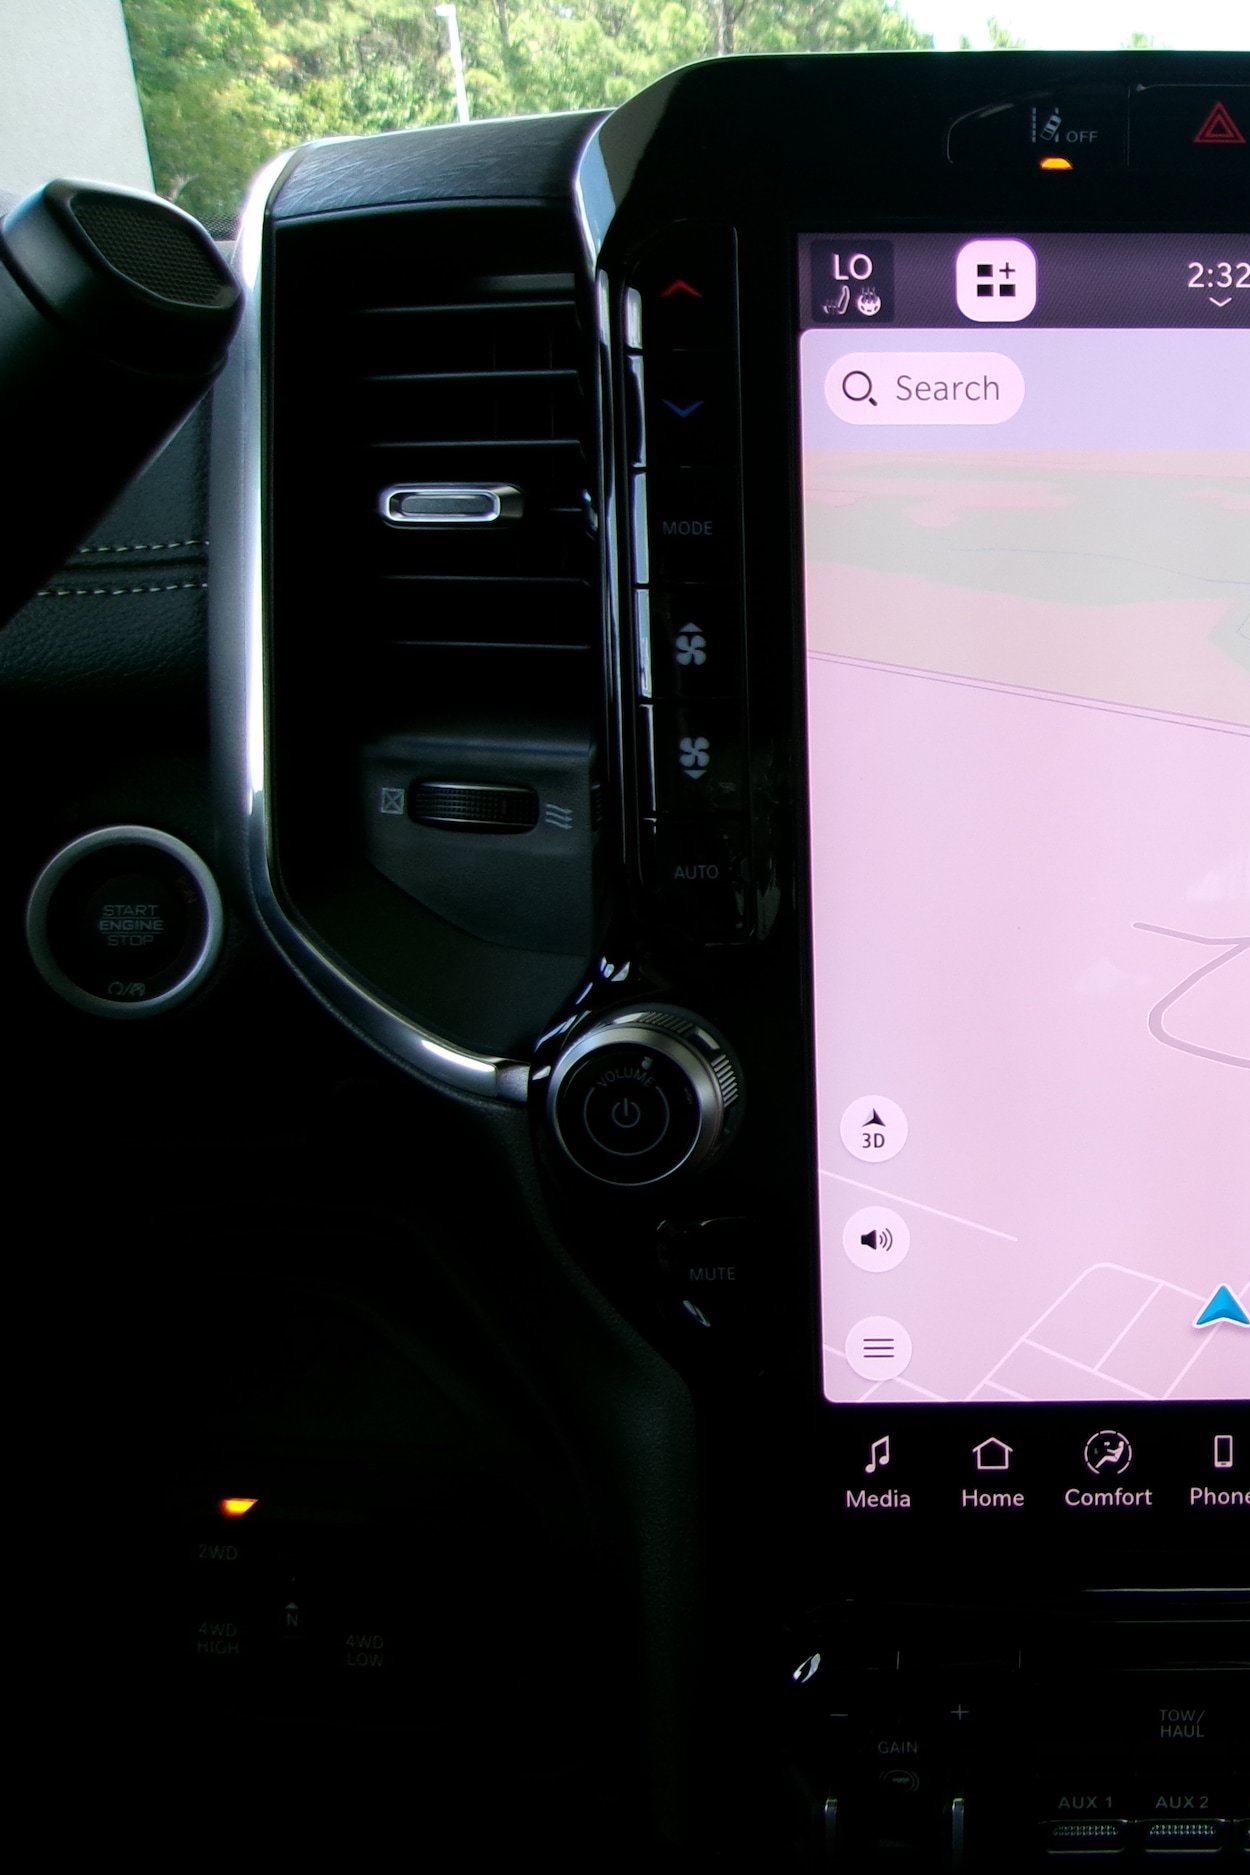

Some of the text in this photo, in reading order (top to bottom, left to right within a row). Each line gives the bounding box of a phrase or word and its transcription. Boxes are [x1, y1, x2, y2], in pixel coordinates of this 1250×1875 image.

[1066, 131, 1098, 143] OFF
[833, 253, 873, 280] LO
[895, 373, 999, 401] Search
[662, 520, 713, 536] MODE
[674, 864, 719, 880] AUTO
[103, 904, 160, 916] START
[100, 920, 164, 931] ENGINE
[107, 934, 154, 946] STOP
[597, 1067, 657, 1089] VOLUME
[862, 1133, 885, 1148] 3D
[688, 1267, 736, 1281] MUTE
[846, 1490, 911, 1509] Media
[962, 1490, 1025, 1508] Home
[1064, 1487, 1152, 1507] Comfort
[199, 1544, 238, 1560] 2WD
[199, 1622, 238, 1637] 4WD
[197, 1640, 240, 1655] HIGH
[345, 1634, 385, 1649] 4WD
[347, 1651, 385, 1668] LOW
[1159, 1709, 1207, 1723] TOW/
[1159, 1724, 1206, 1738] HAUL
[877, 1740, 918, 1754] GAIN
[1058, 1796, 1113, 1809] AUX 1
[1155, 1795, 1209, 1809] AUX 2
